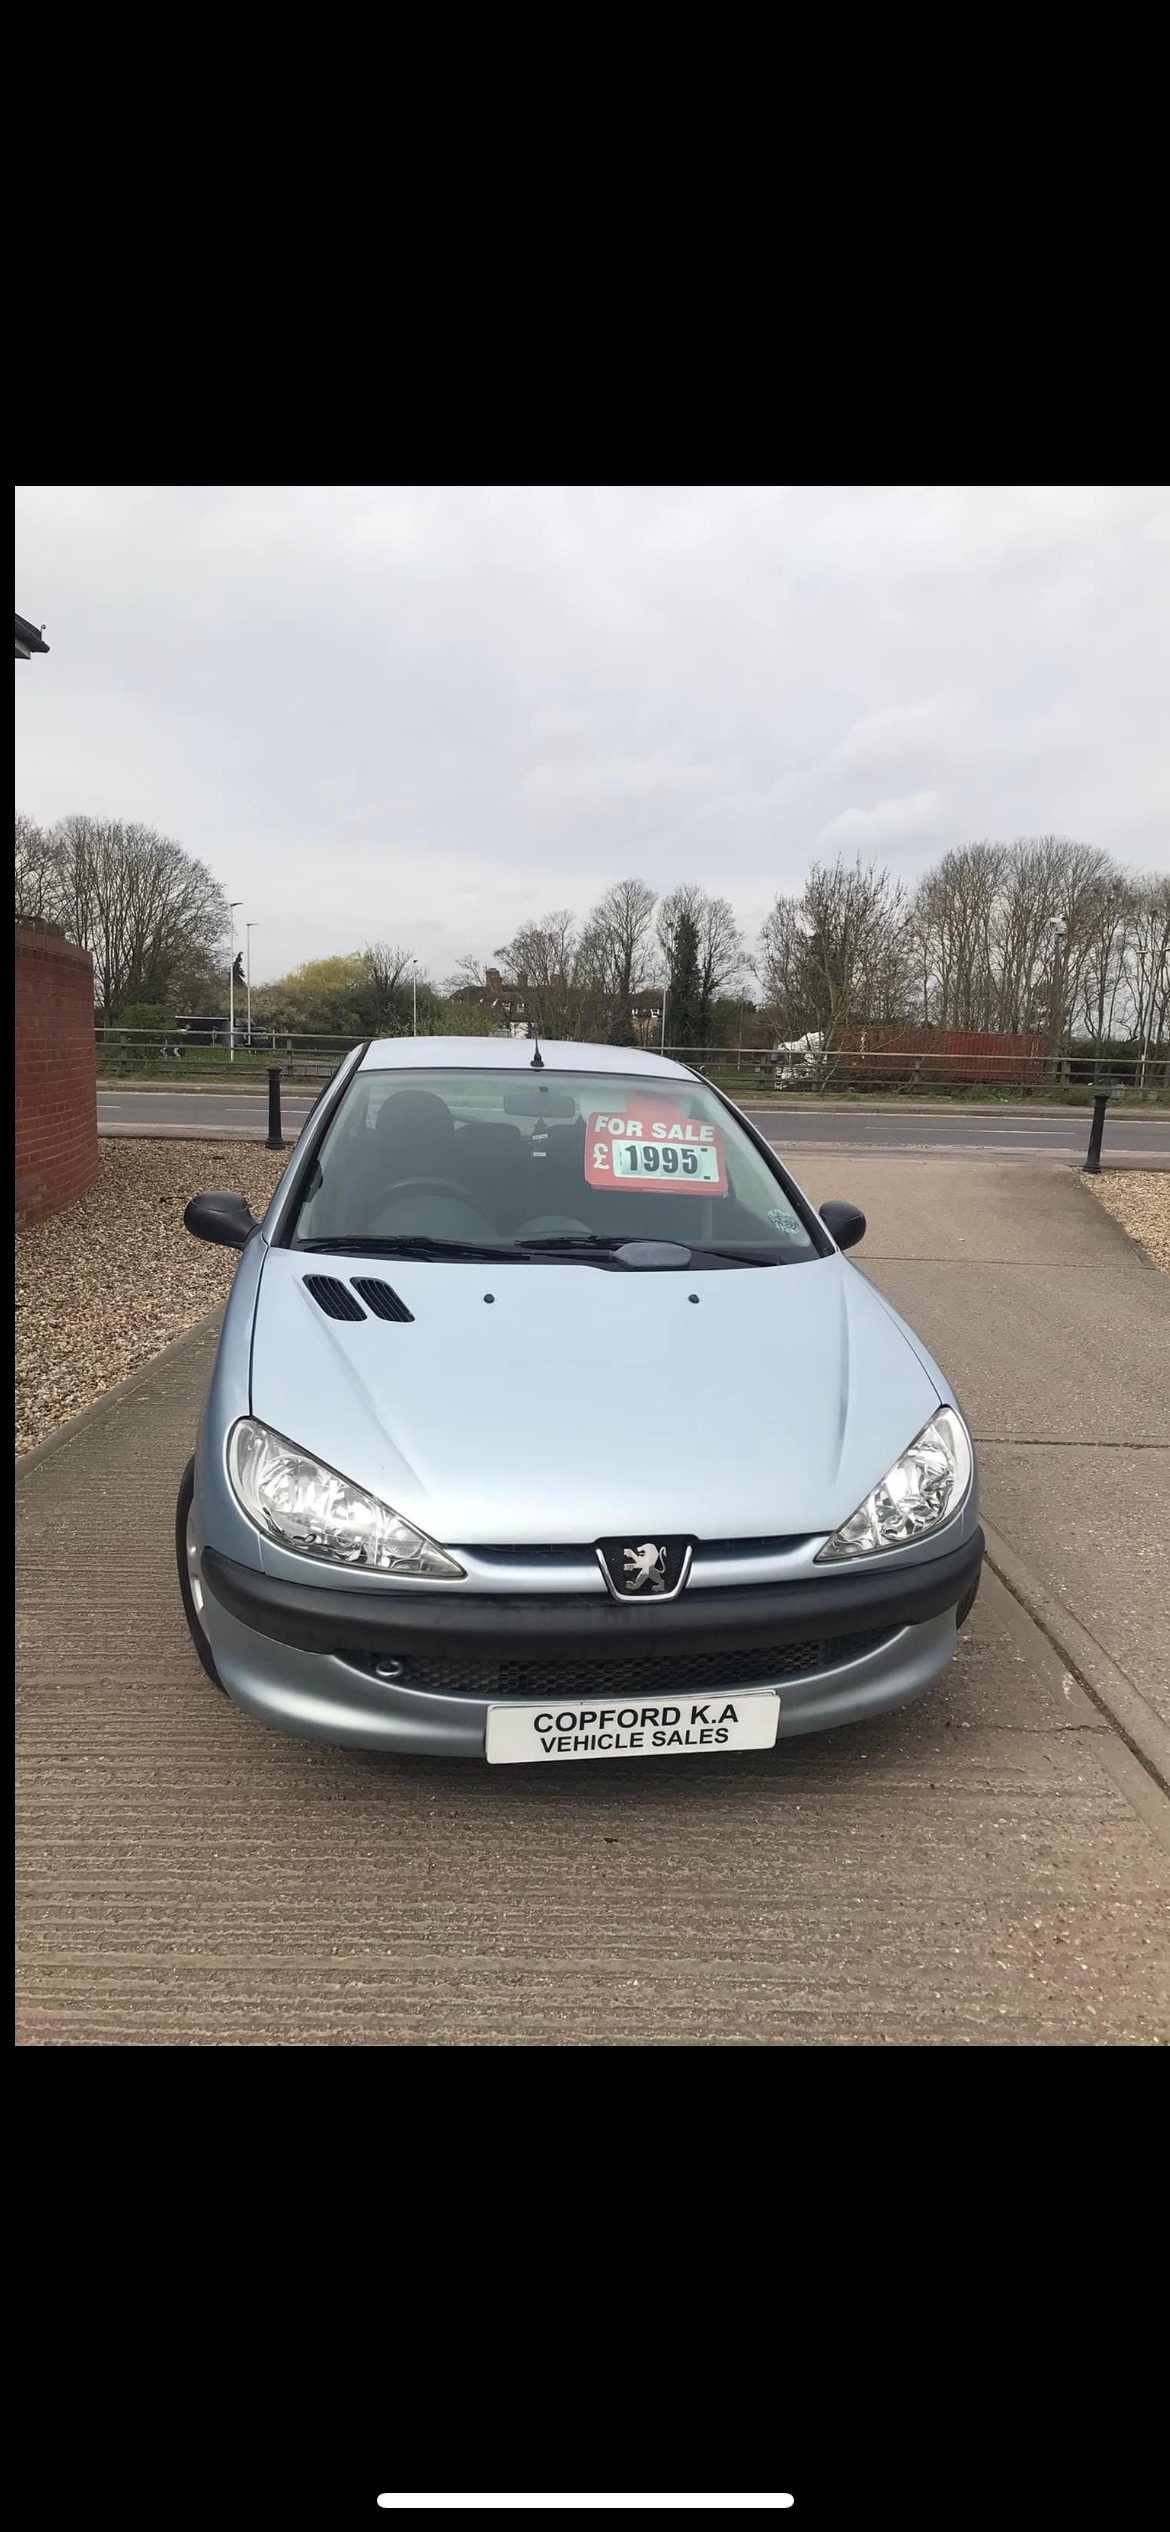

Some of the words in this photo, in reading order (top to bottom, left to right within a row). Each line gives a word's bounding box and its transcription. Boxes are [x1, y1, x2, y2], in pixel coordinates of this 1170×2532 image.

[594, 1116, 643, 1137] FOR
[652, 1122, 715, 1142] SALE
[593, 1143, 610, 1170] £
[625, 1145, 698, 1174] 1995
[533, 1707, 681, 1733] COPFORD
[690, 1704, 739, 1725] K.A
[540, 1732, 644, 1753] VEHICLE
[651, 1728, 730, 1748] SALES
